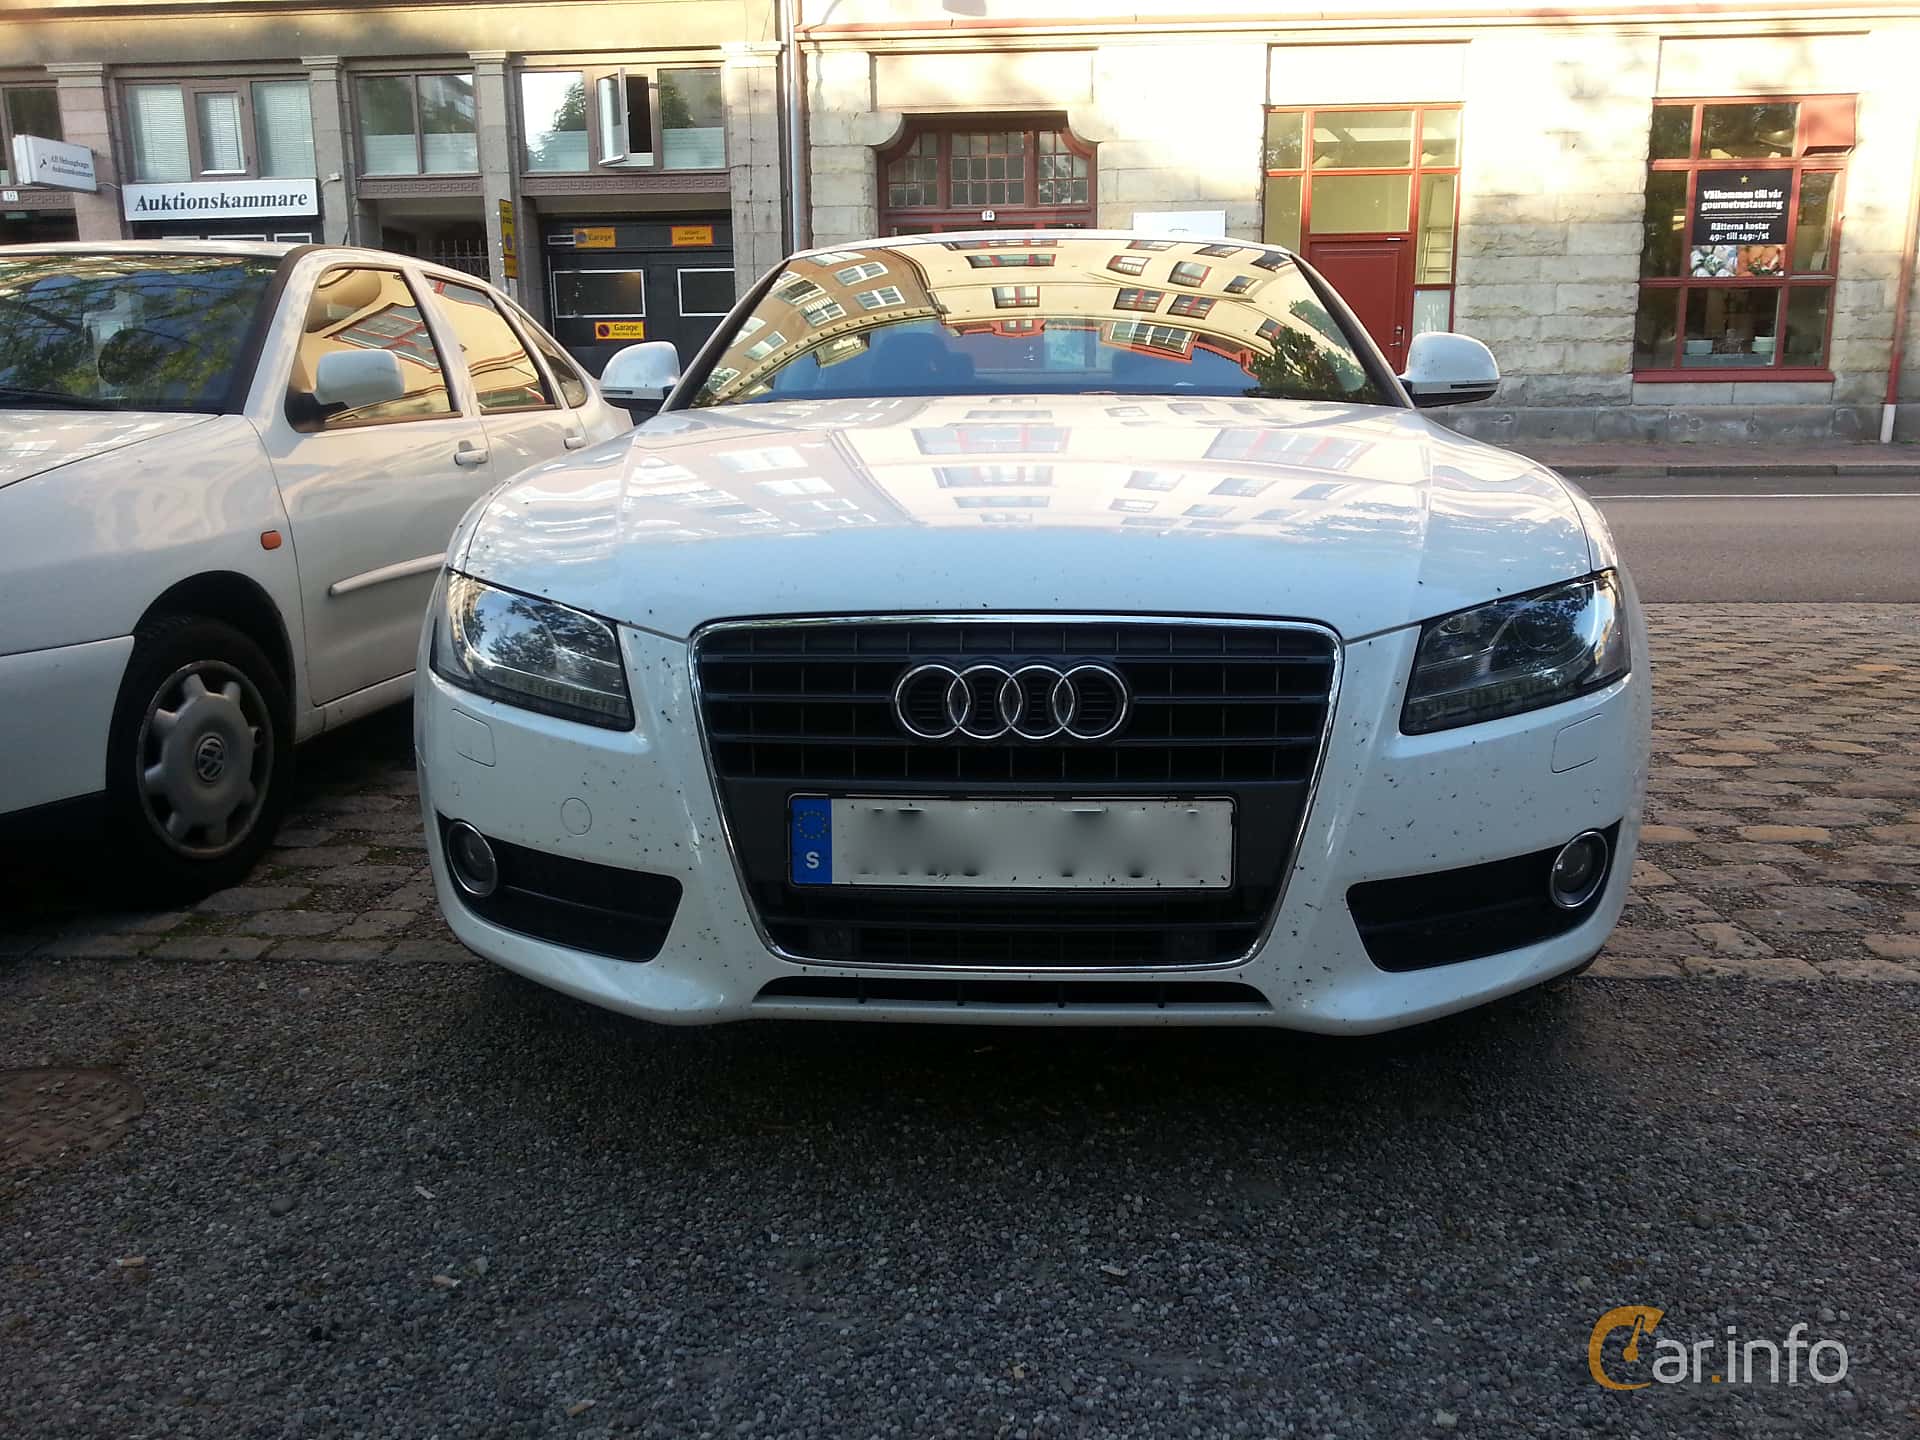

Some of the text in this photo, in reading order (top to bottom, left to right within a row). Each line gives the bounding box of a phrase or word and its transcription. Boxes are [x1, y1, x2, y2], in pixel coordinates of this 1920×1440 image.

[1754, 189, 1767, 199] till
[1768, 189, 1783, 198] vår
[135, 192, 308, 212] Auktionskammare
[1701, 200, 1783, 211] gourmetrestaurang
[1745, 222, 1770, 230] kostar
[1726, 232, 1738, 240] till
[805, 851, 820, 869] S
